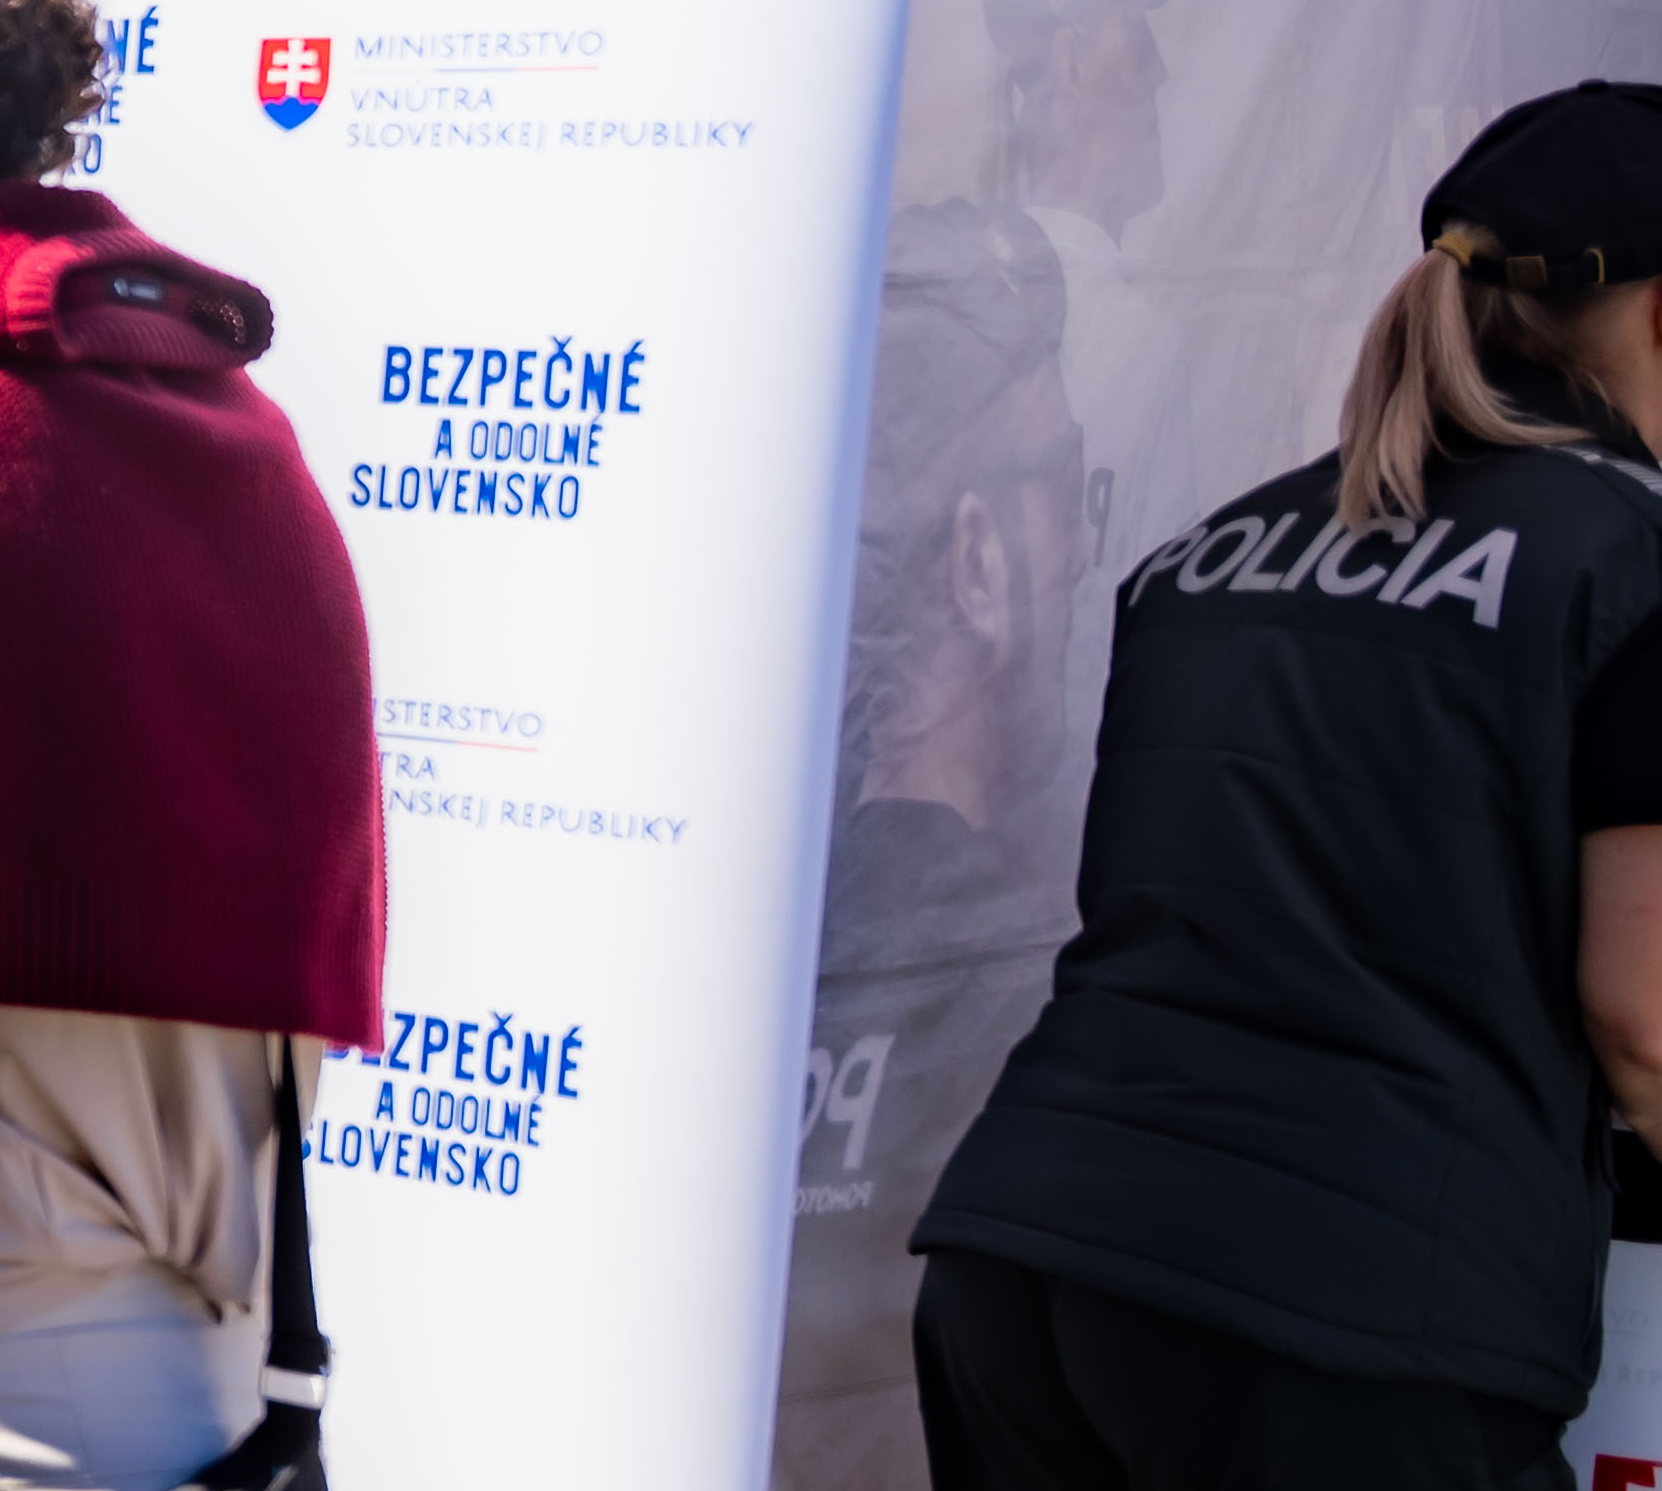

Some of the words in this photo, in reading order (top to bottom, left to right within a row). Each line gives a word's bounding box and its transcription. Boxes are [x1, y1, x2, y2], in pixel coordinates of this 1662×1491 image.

[354, 28, 606, 60] MINISTERSTVO
[350, 78, 494, 113] VNÚTRA
[346, 119, 545, 153] SLOVENSKEJ
[559, 118, 755, 150] REPUBLIKY
[381, 335, 647, 415] BEZPEČNÉ
[435, 419, 453, 461] A
[469, 414, 604, 468] ODOLNÉ
[350, 462, 581, 520] SLOVENSKO
[378, 750, 438, 781] TRA
[389, 788, 487, 829] NSKEJ
[499, 800, 689, 845] REPUBLIKY
[325, 1010, 583, 1099] ZPEČNÉ
[376, 1082, 394, 1123] A
[412, 1095, 543, 1147] ODOLNÉ
